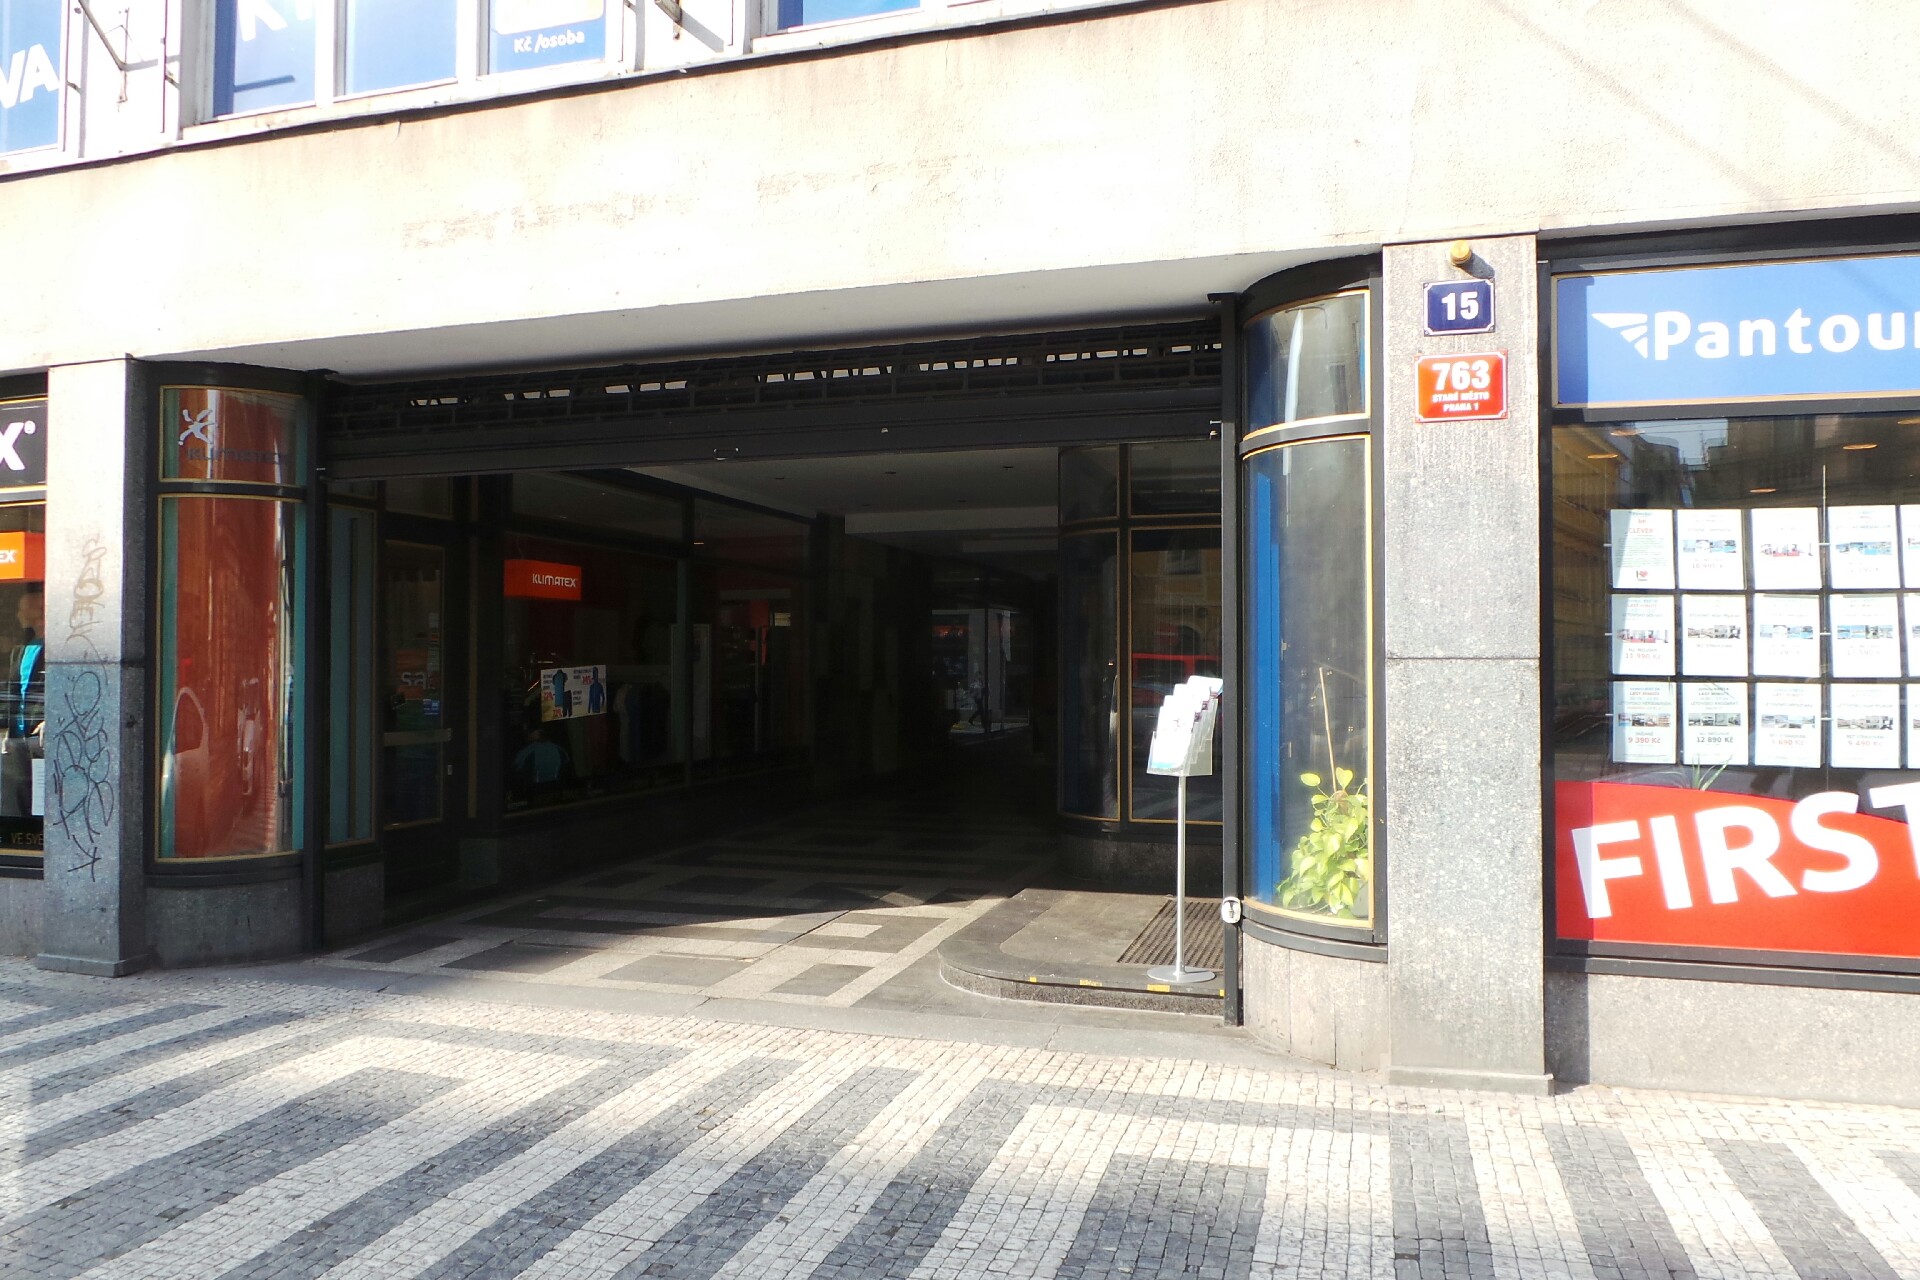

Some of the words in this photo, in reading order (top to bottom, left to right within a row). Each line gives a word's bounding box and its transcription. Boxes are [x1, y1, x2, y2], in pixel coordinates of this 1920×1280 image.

[514, 35, 533, 54] Kč
[1441, 291, 1480, 321] 15
[1432, 360, 1491, 391] 763
[1432, 391, 1459, 403] STARÉ
[1460, 389, 1490, 401] MĚSTO
[1443, 402, 1472, 412] PRAHA
[1473, 402, 1479, 411] 1
[532, 573, 577, 588] KLIMATEX
[1571, 782, 1920, 919] FIRST
